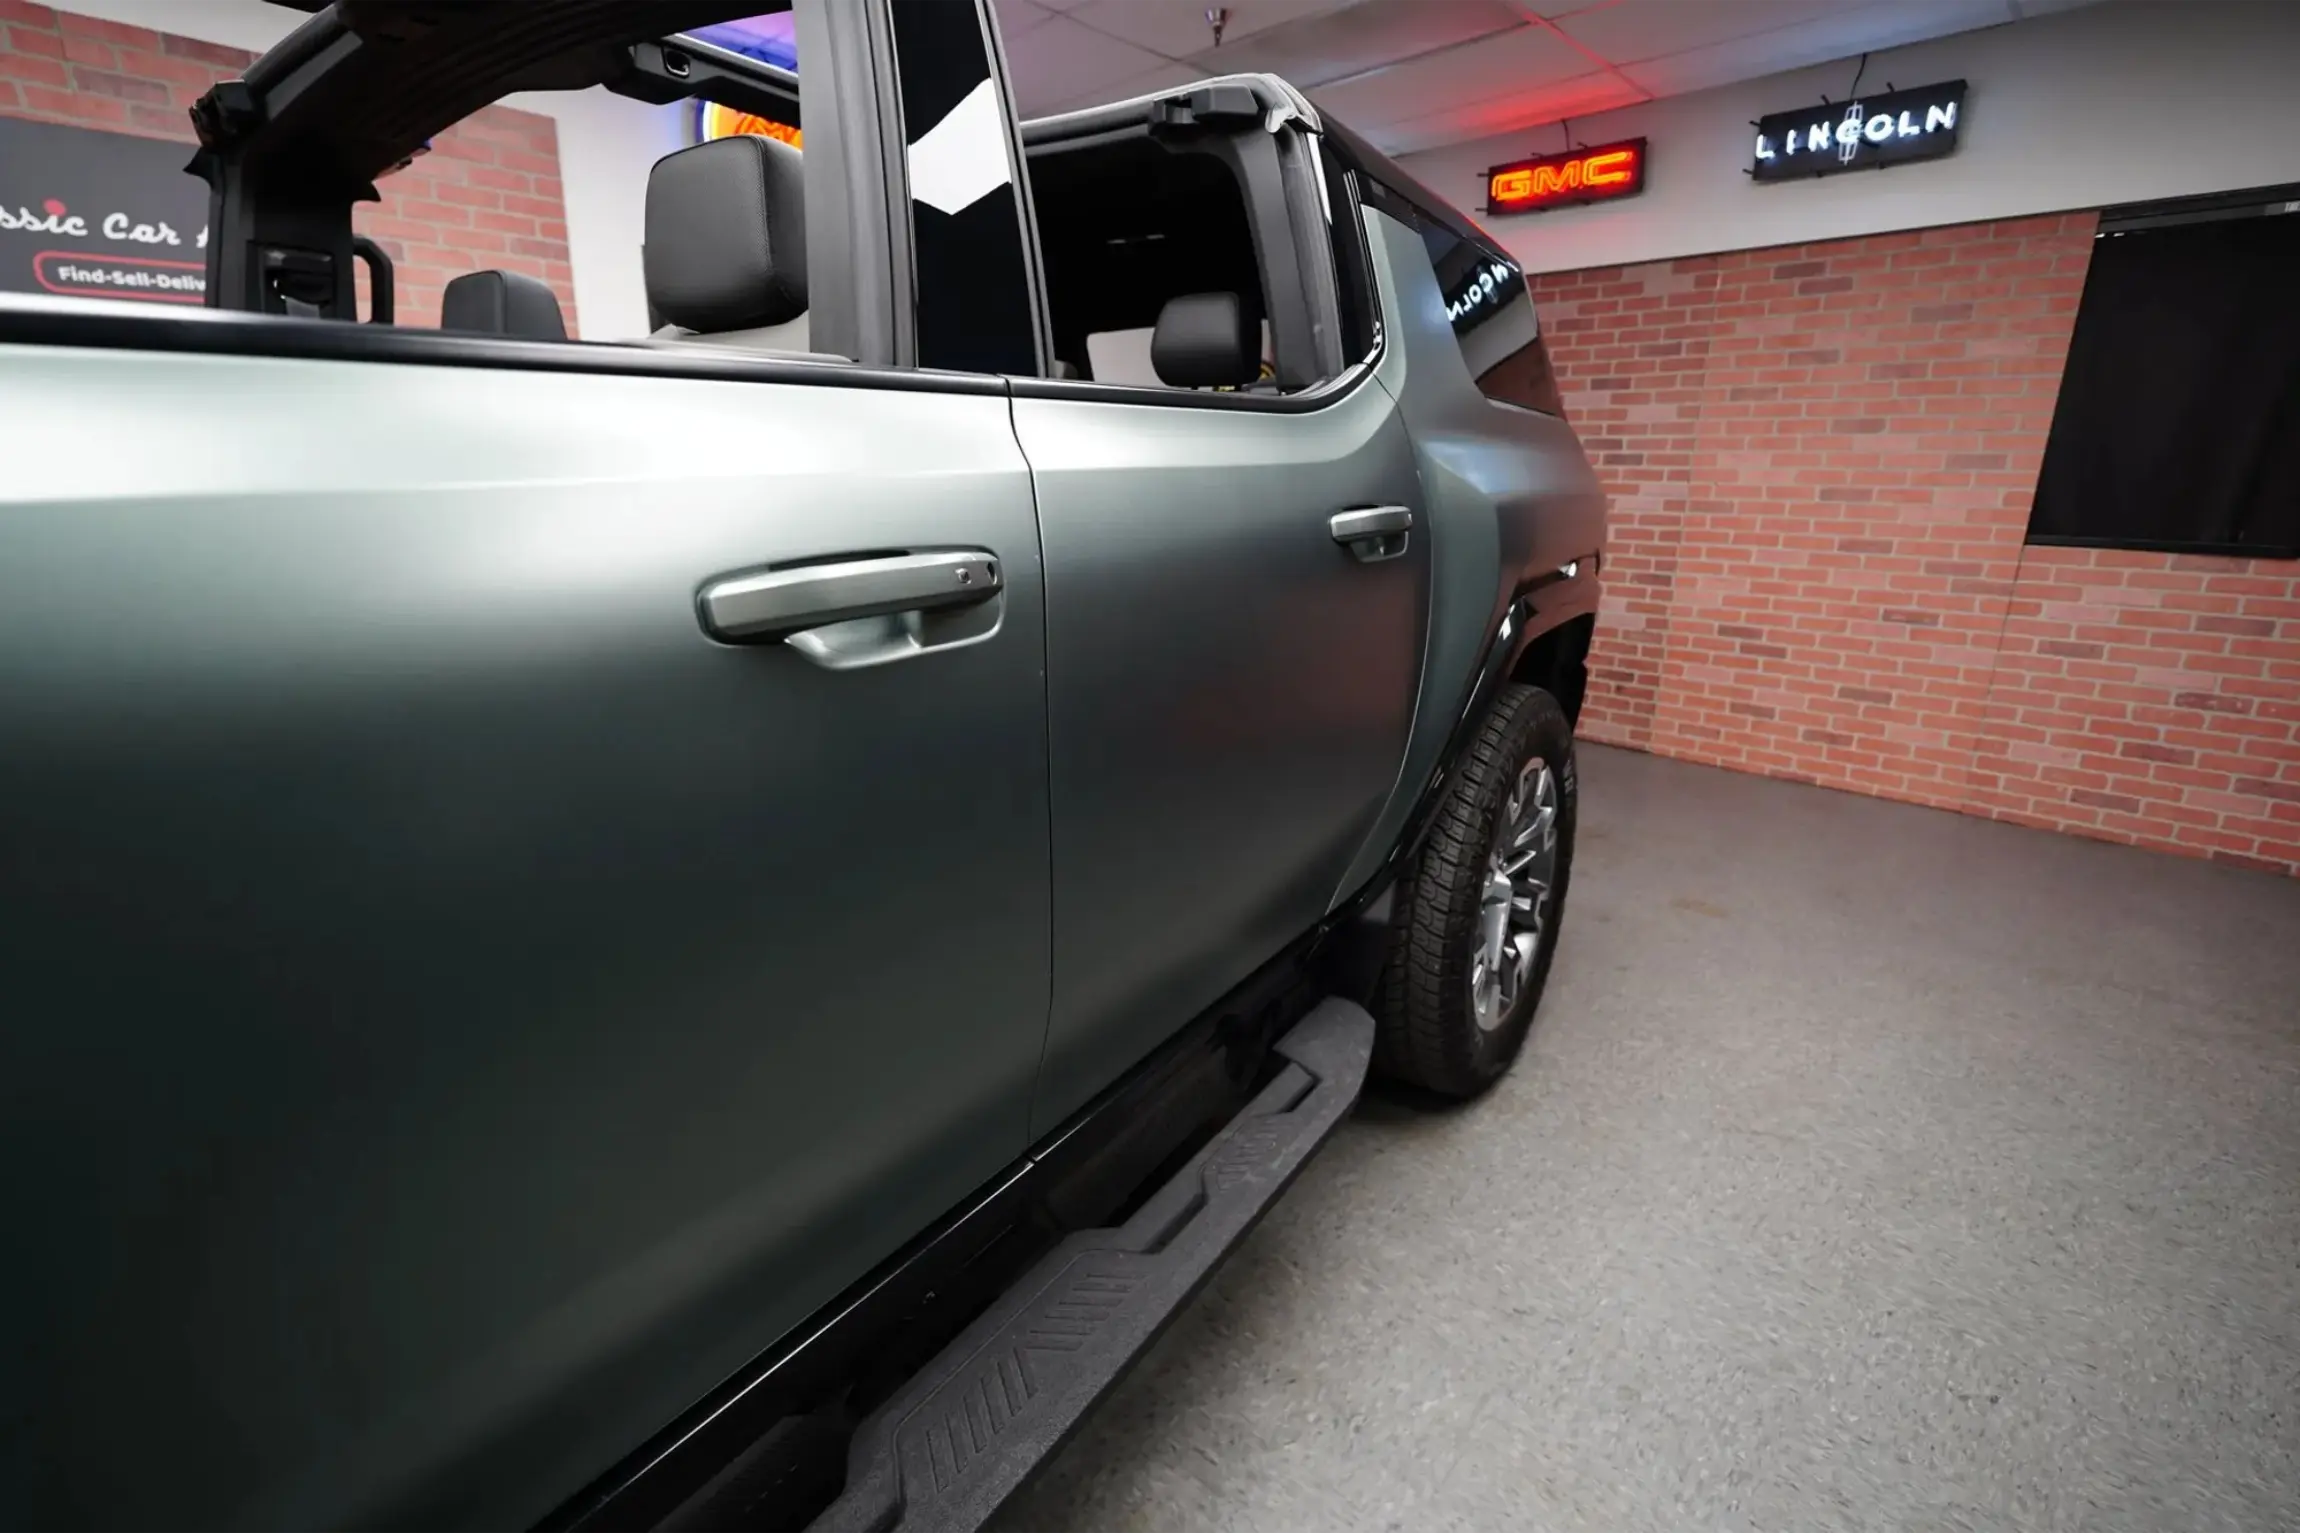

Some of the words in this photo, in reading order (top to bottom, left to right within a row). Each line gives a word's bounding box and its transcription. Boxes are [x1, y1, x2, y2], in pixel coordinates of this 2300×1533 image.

[1756, 101, 1957, 159] LINCOLN
[1491, 151, 1633, 202] GMC
[102, 212, 181, 246] Car
